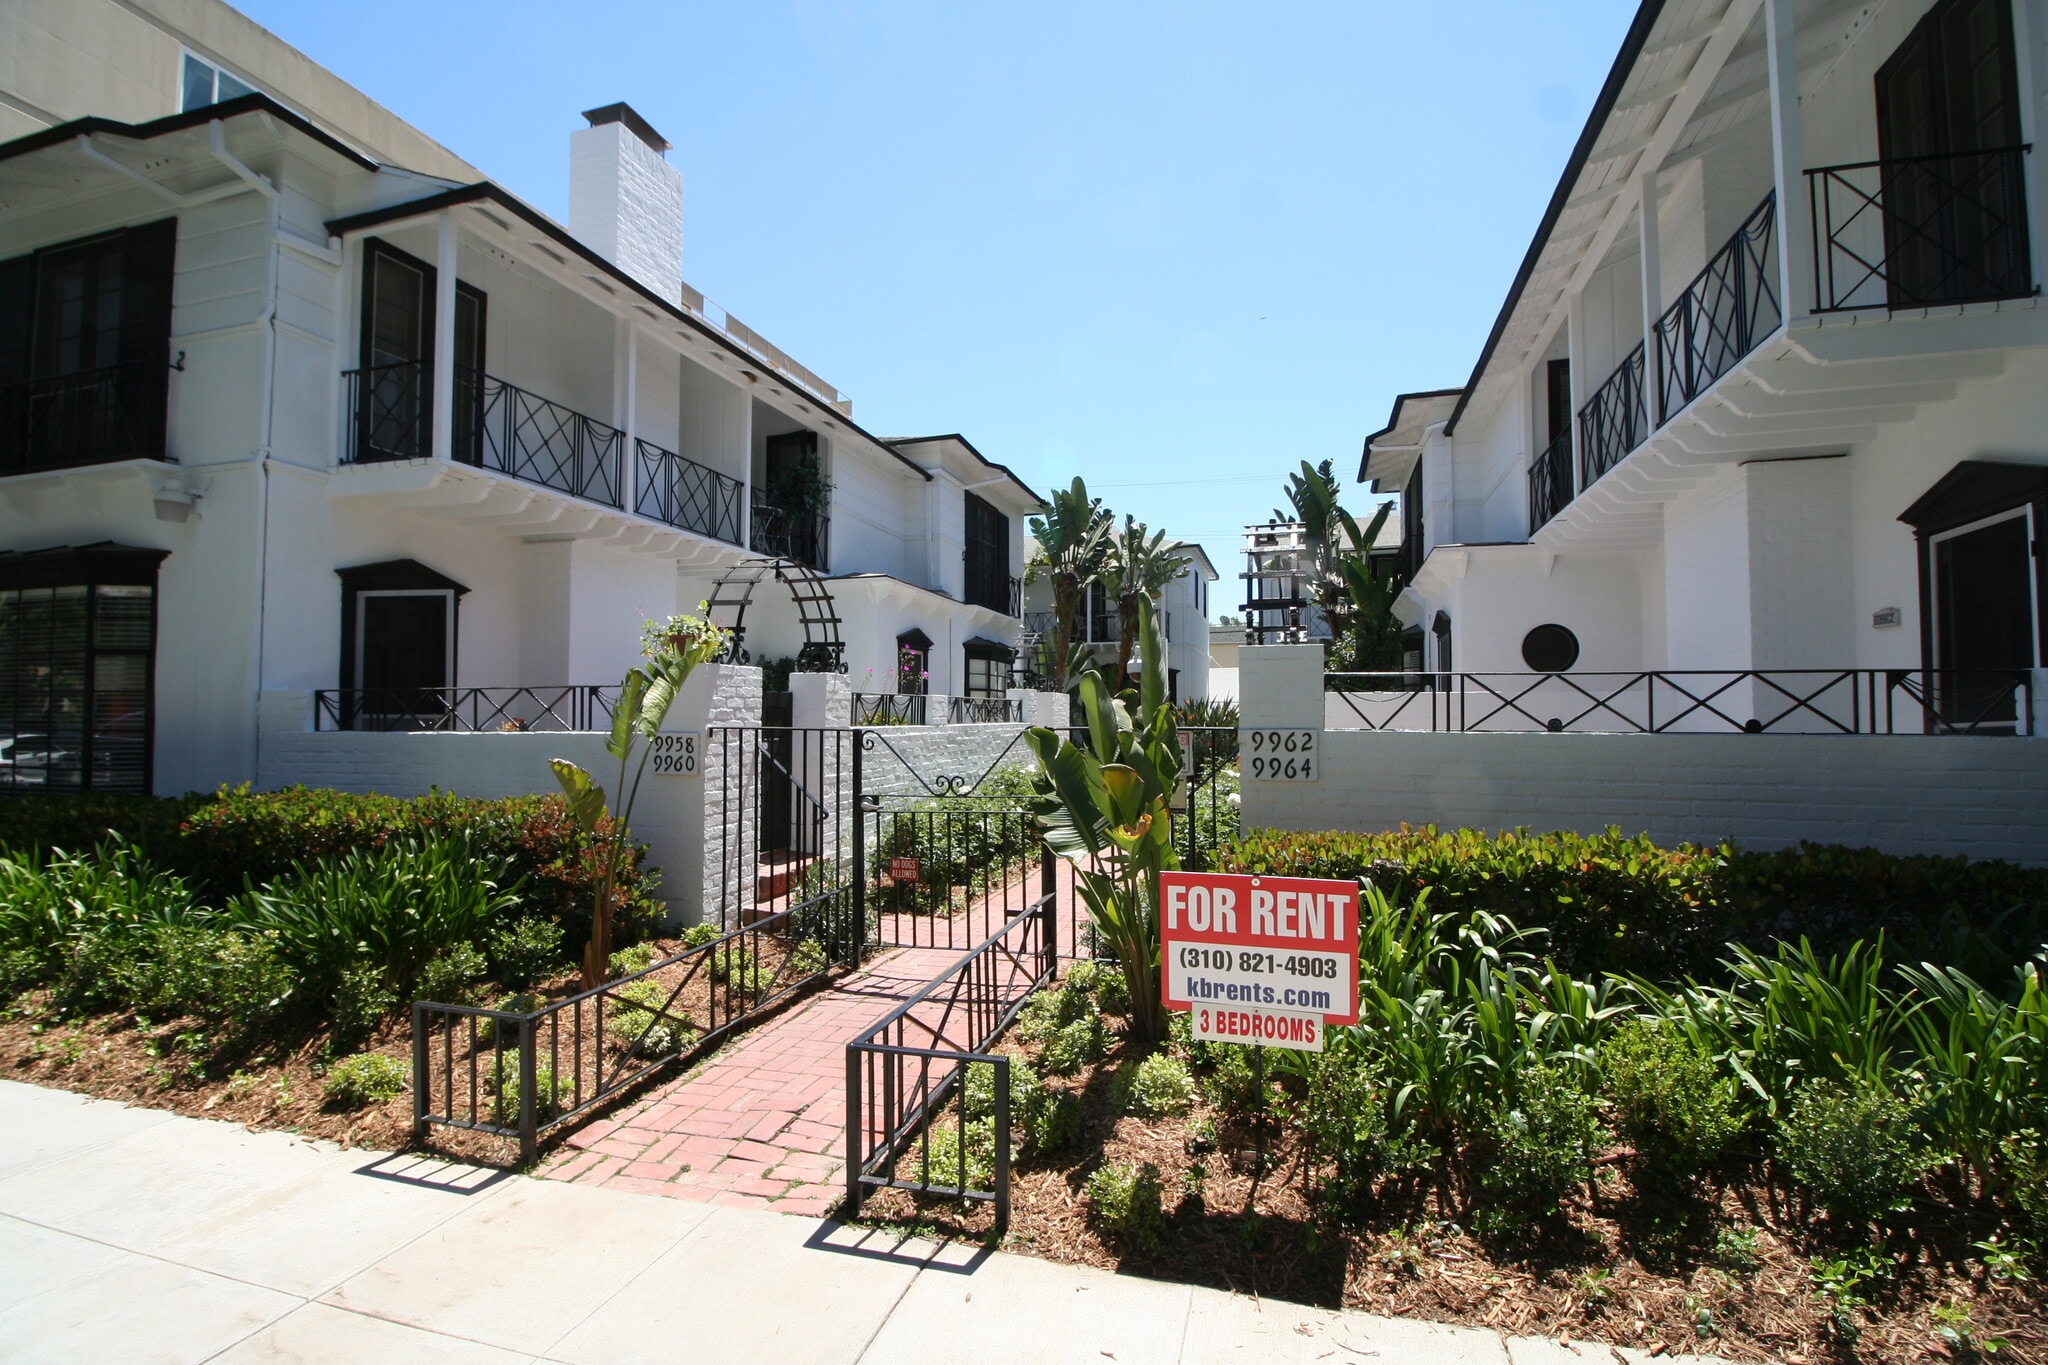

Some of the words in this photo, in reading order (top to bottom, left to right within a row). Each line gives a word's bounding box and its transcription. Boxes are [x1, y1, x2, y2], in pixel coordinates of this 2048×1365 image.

[654, 735, 694, 753] 9958
[1251, 731, 1313, 753] 9962
[653, 755, 695, 772] 9960
[1252, 757, 1312, 779] 9964
[891, 869, 917, 879] ALLOWED
[892, 860, 900, 868] NO
[901, 860, 916, 869] DOGS
[1167, 885, 1237, 934] FOR
[1250, 889, 1350, 941] RENT
[1179, 947, 1233, 972] (310)
[1239, 952, 1337, 979] 821-4903
[1187, 976, 1331, 1009] kbrents.com
[1200, 1009, 1210, 1033] 3
[1216, 1011, 1316, 1043] BEDROOMS
